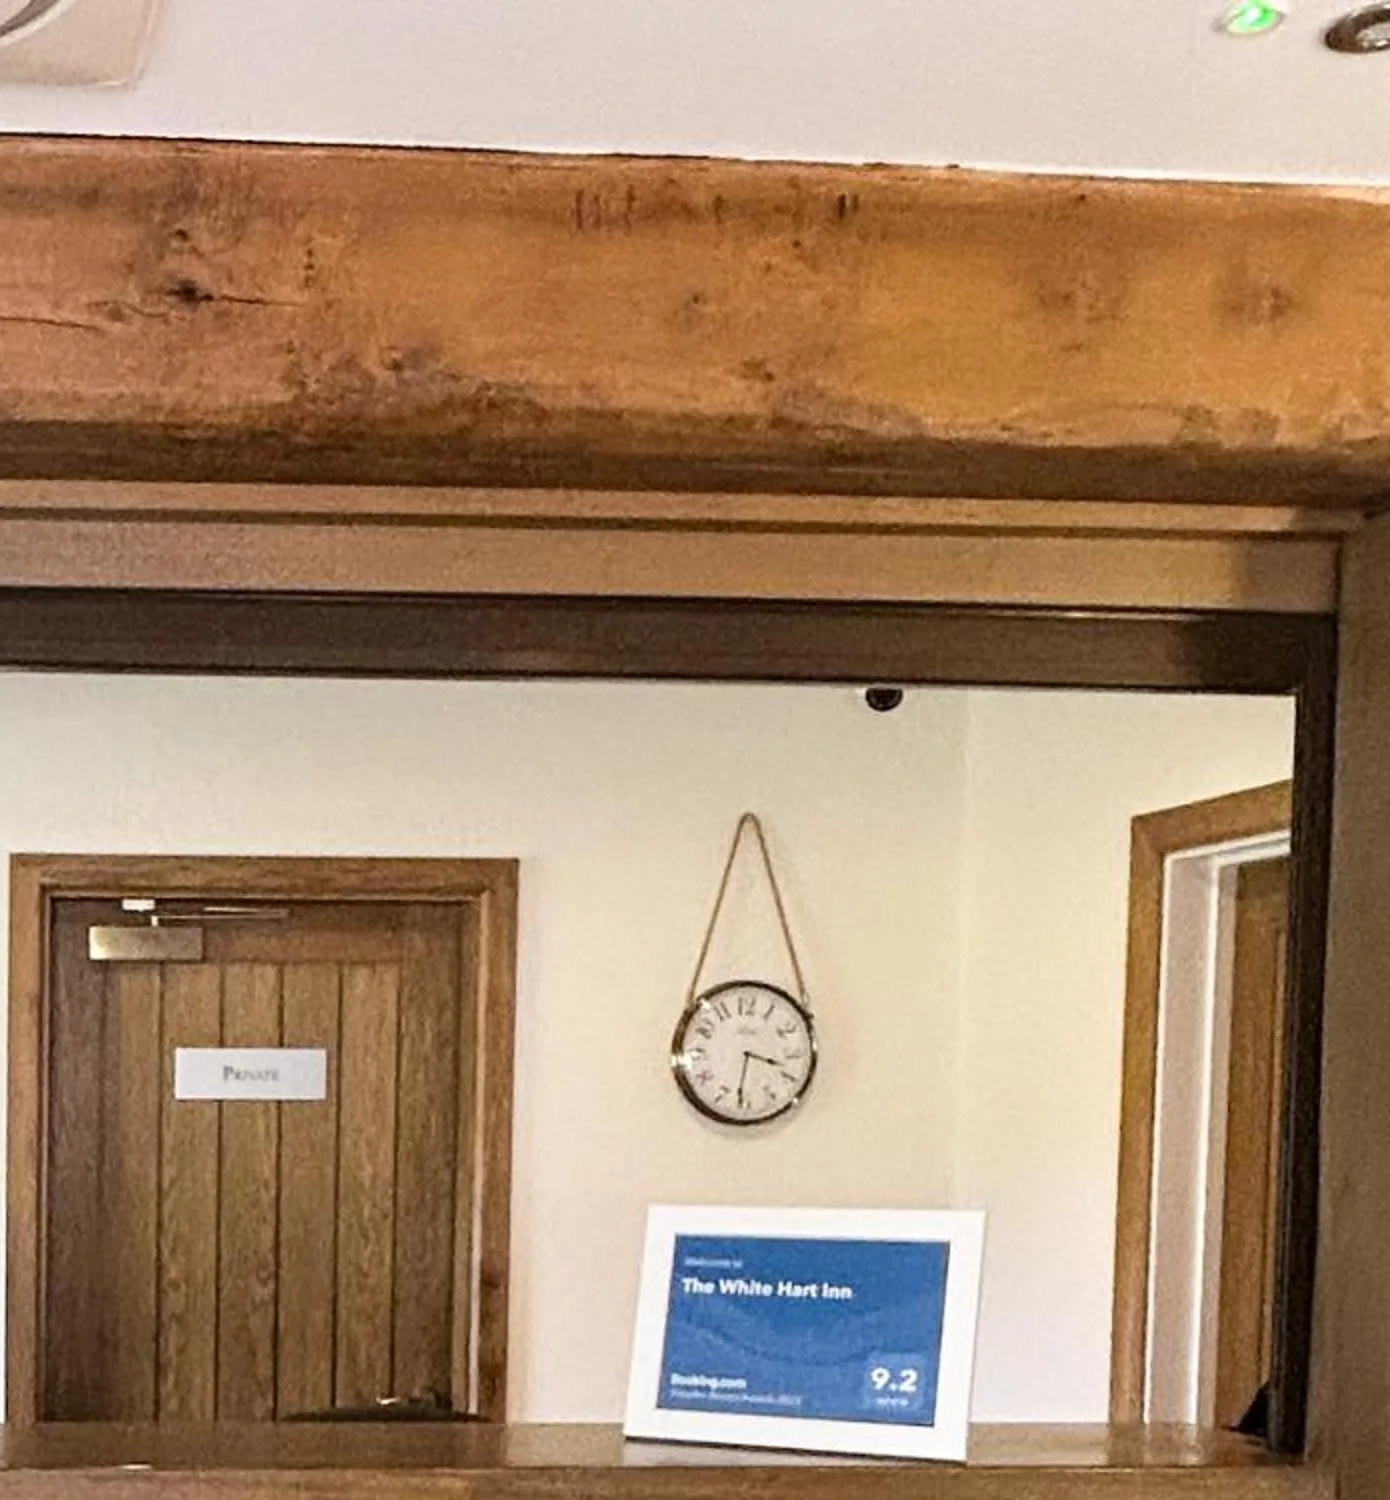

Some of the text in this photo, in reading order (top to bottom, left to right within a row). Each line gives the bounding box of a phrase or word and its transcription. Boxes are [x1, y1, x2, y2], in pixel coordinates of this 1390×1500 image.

[682, 1277, 853, 1299] The White Hart Inn
[870, 1366, 918, 1392] 9.2
